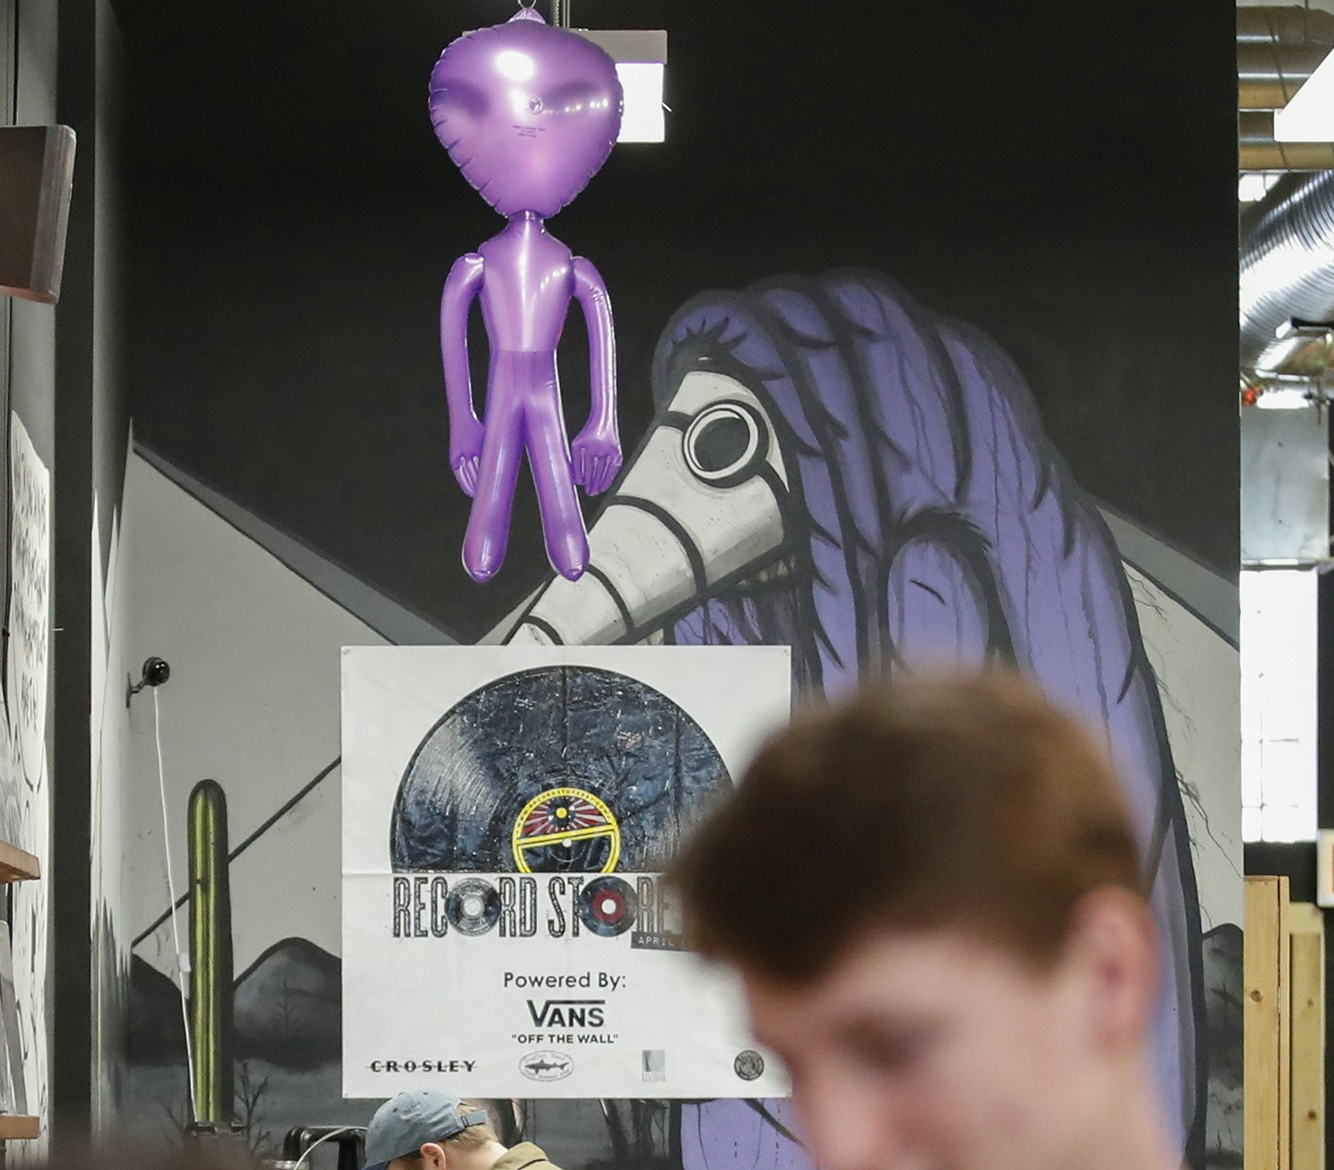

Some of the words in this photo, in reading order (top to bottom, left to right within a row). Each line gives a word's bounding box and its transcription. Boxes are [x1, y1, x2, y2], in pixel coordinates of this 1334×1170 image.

[393, 876, 538, 938] RECORD
[637, 935, 674, 947] APRIL
[504, 971, 591, 988] Powered
[598, 972, 627, 992] By:
[526, 999, 606, 1028] VANS
[511, 1034, 544, 1045] "OFF
[548, 1034, 574, 1044] THE
[577, 1034, 619, 1044] WALL"
[369, 1060, 476, 1073] CROSLEY
